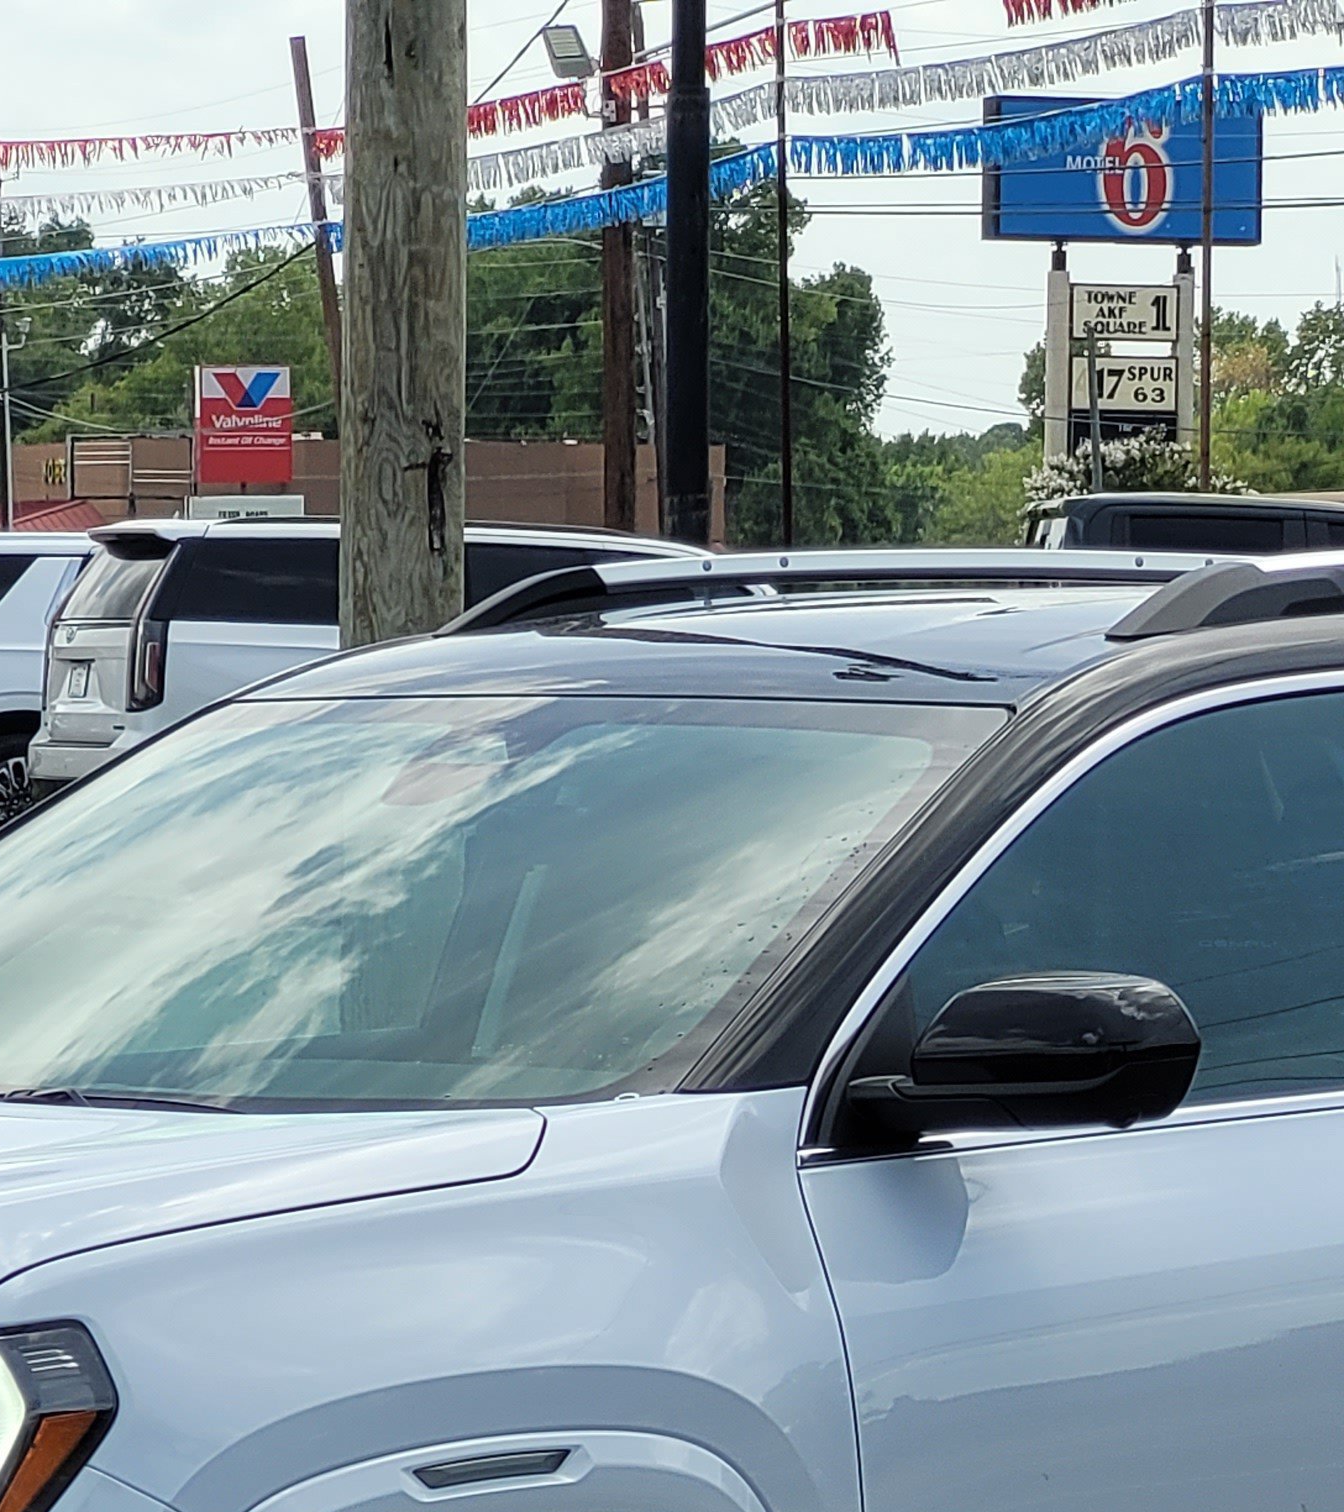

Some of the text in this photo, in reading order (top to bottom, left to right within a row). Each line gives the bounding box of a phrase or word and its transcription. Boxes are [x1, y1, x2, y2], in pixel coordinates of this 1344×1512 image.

[1065, 155, 1125, 174] MOTEL
[1084, 290, 1137, 305] TOWNE
[1082, 320, 1147, 335] SQUARE
[1127, 366, 1174, 382] SPUR
[1133, 387, 1166, 404] 63
[208, 436, 240, 446] Instant
[253, 436, 287, 446] Change
